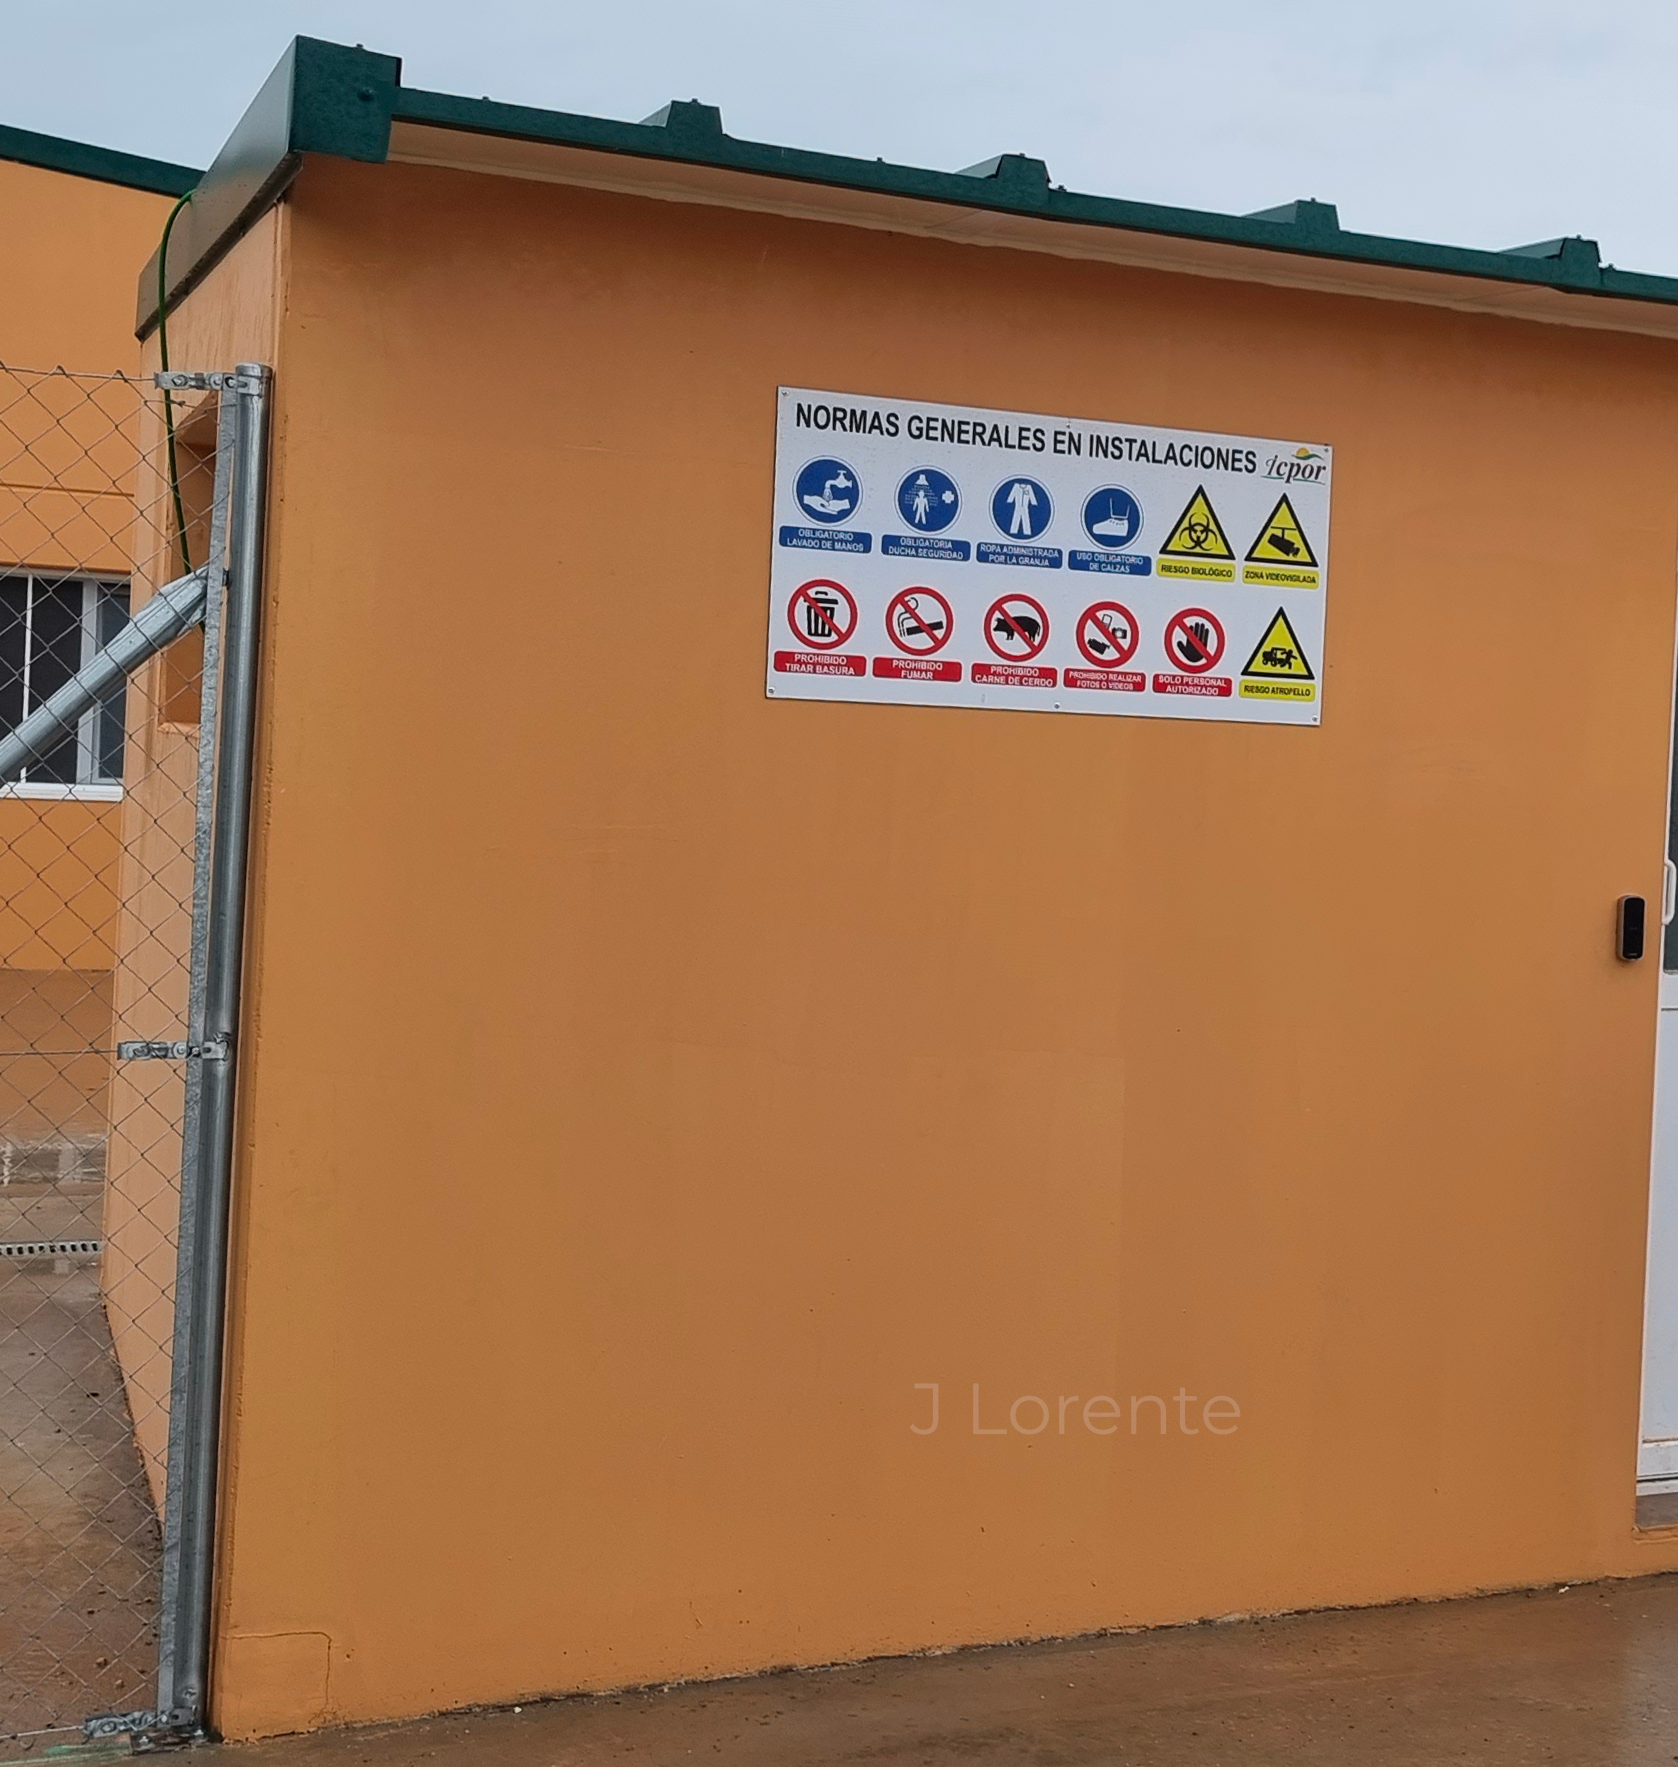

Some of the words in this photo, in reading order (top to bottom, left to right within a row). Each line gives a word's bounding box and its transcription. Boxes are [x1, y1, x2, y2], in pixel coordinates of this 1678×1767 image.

[796, 402, 900, 438] NORMAS
[907, 415, 1046, 453] GENERALES
[1053, 430, 1082, 456] EN
[1089, 434, 1257, 474] INSTALACIONES
[798, 528, 854, 541] OBLIGATORIO
[787, 537, 820, 548] LAVADO
[821, 540, 833, 549] DE
[834, 541, 864, 552] MANOS
[900, 537, 953, 549] OBLIGATORIA
[888, 546, 916, 556] DUCHA
[918, 548, 963, 560] SEGURIDAD
[980, 543, 1001, 553] ROPA
[1002, 545, 1059, 558] ADMINISTRADA
[988, 554, 1006, 564] POR
[1006, 556, 1017, 564] LA
[1018, 556, 1050, 567] GRANJA
[1076, 552, 1092, 561] USO
[1093, 553, 1144, 565] OBLIGATORIO
[1089, 562, 1099, 571] DE
[1100, 563, 1130, 573] CALZAS
[1161, 564, 1190, 574] RIESGO
[1191, 566, 1232, 578] BIOLÓGICO
[1244, 570, 1264, 579] ZONA
[1265, 572, 1317, 584] VIDEOVIGILADA
[794, 653, 847, 665] PROHIBIDO
[785, 663, 814, 672] TIRAR
[815, 665, 855, 675] BASURA
[892, 660, 943, 671] PROHIBIDO
[990, 665, 1040, 677] PROHIBIDO
[901, 670, 934, 680] FUMAR
[975, 675, 1006, 684] CARNE
[1008, 676, 1020, 685] DE
[1021, 677, 1053, 687] CERDO
[1068, 671, 1108, 681] PROHIBIDO
[1108, 673, 1142, 683] REALIZAR
[1158, 675, 1182, 684] SOLO
[1183, 676, 1227, 687] PERSONAL
[1076, 680, 1101, 689] FOTOS
[1101, 681, 1107, 689] O
[1165, 685, 1219, 696] AUTORIZADO
[1243, 684, 1270, 694] RIESGO
[1270, 686, 1311, 697] ATROPELLO
